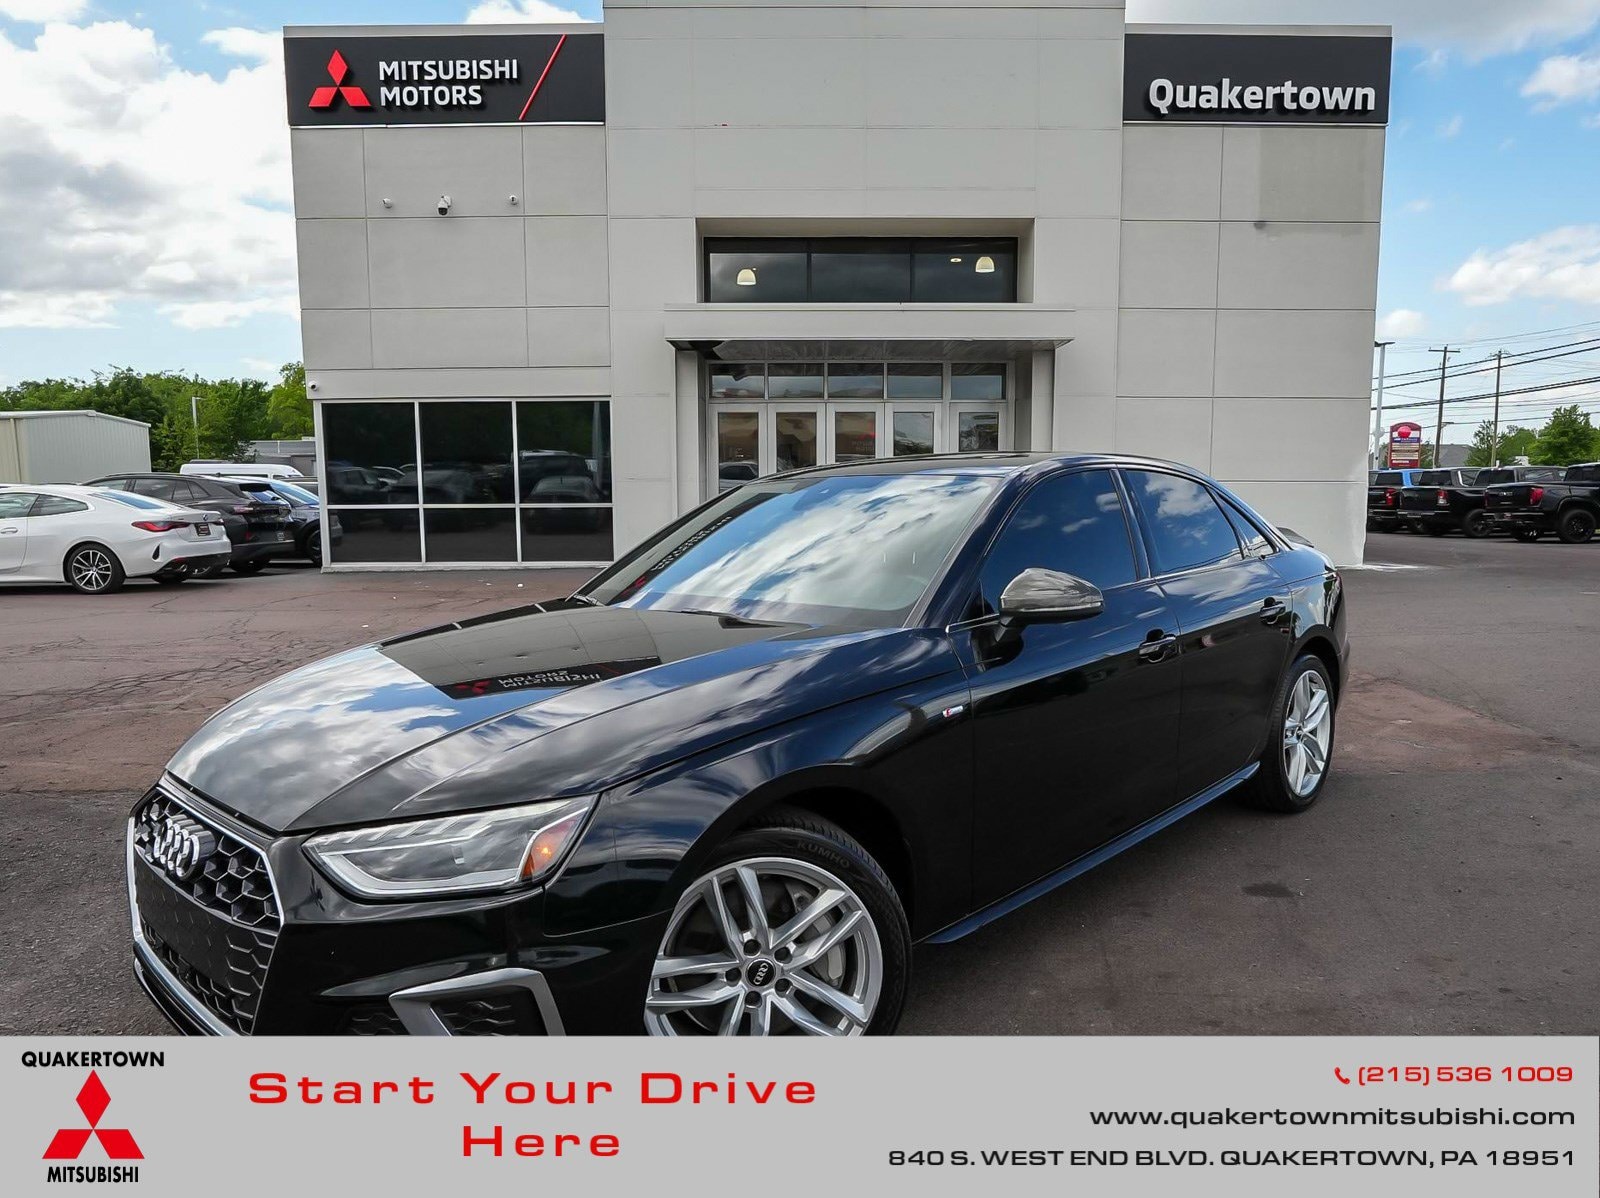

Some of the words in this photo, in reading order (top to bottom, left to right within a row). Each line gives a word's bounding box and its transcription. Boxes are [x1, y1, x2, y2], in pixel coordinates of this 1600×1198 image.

[379, 59, 518, 81] MITSUBISHI
[380, 85, 482, 107] MOTORS
[1149, 78, 1376, 114] Quakertown
[797, 841, 851, 868] KUMHO
